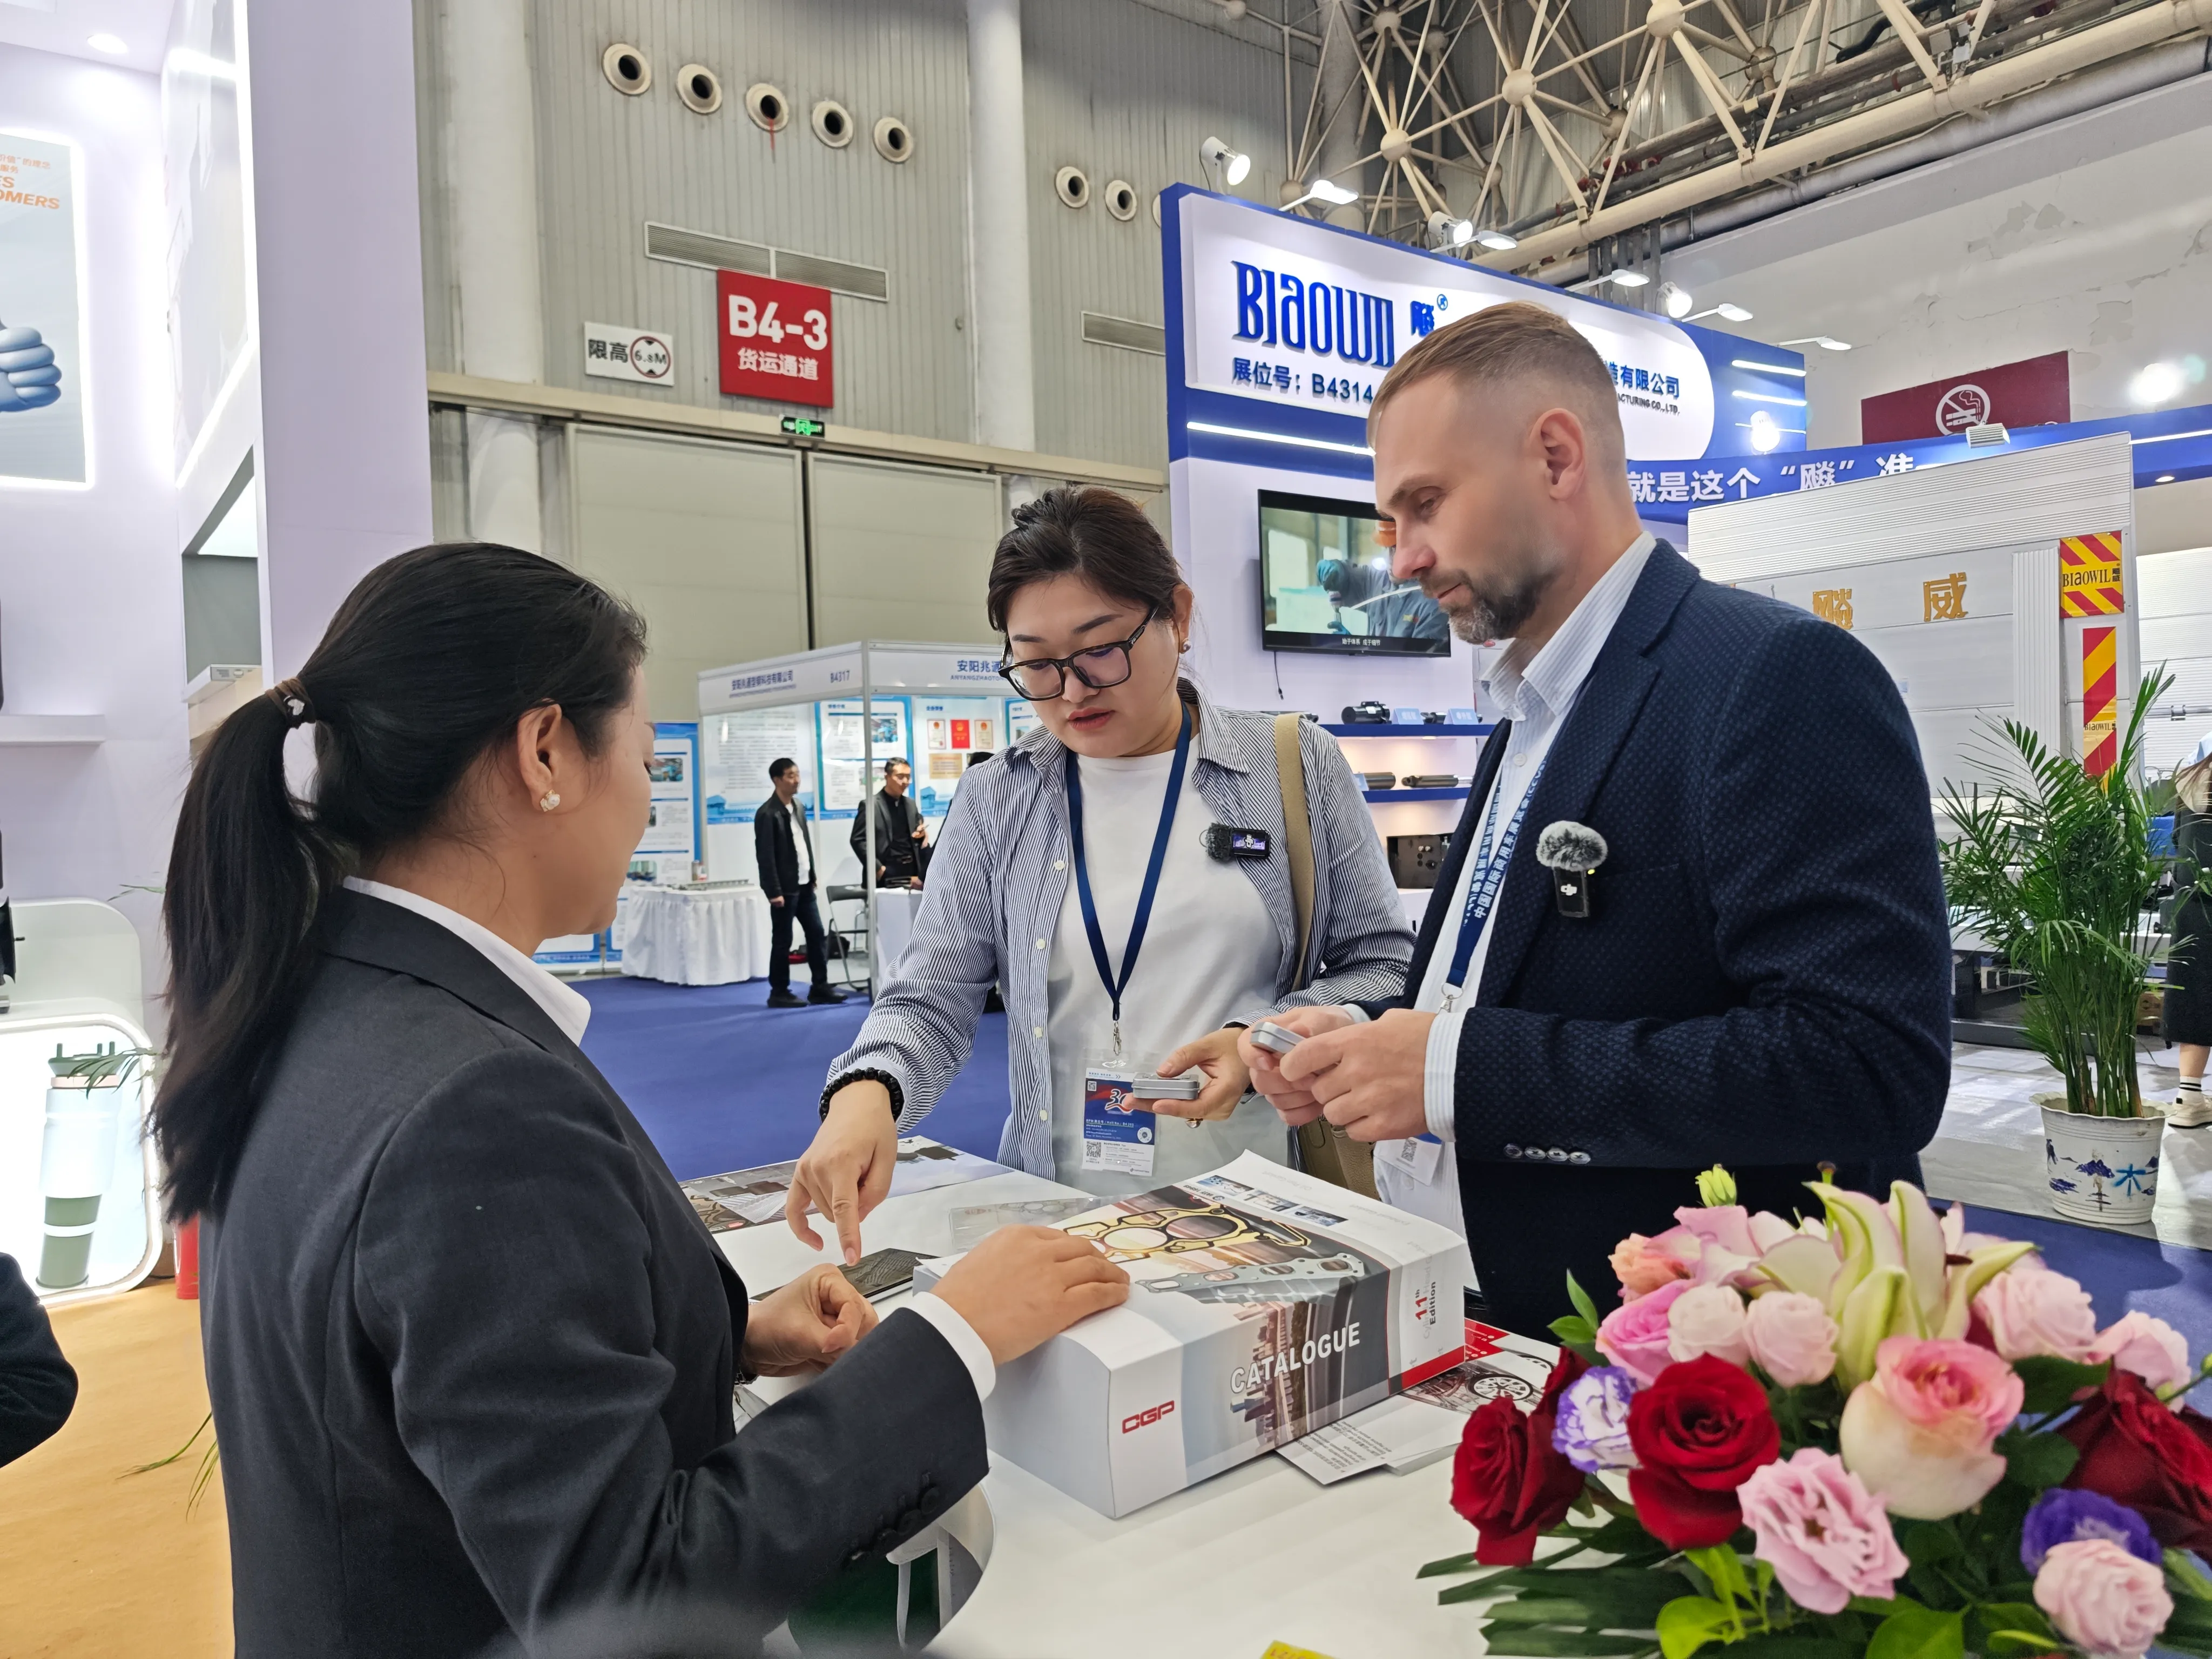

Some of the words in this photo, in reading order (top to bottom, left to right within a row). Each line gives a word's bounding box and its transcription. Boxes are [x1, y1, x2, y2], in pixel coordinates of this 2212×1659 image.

[728, 294, 828, 350] B4-3
[588, 339, 628, 363] 限高
[737, 347, 819, 380] 货运通道
[830, 670, 850, 683] B4317
[1231, 1321, 1360, 1394] CATALOGUE
[1122, 1400, 1175, 1434] CGP
